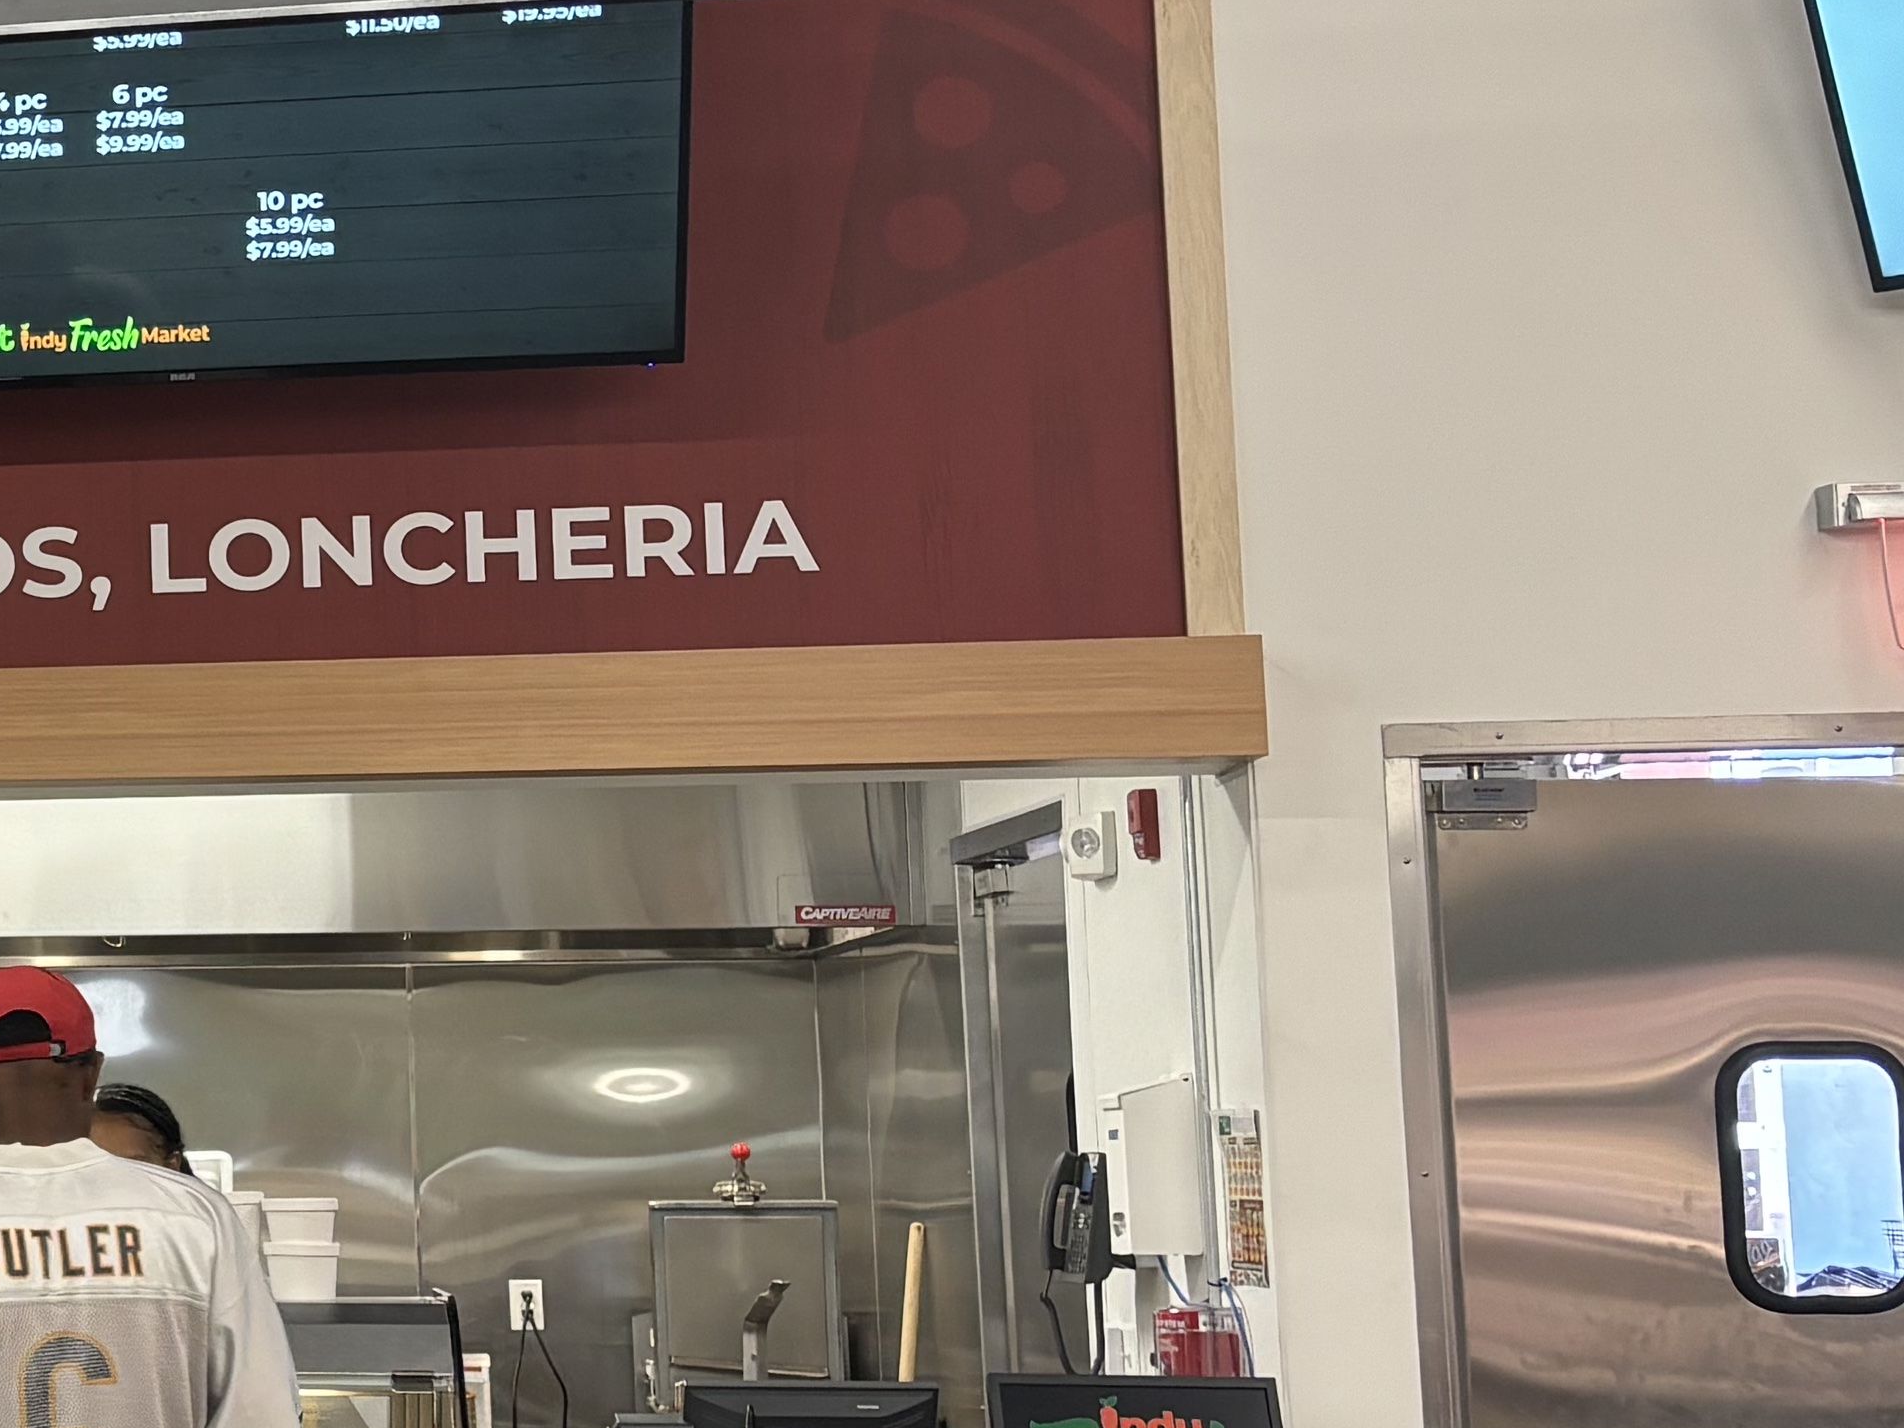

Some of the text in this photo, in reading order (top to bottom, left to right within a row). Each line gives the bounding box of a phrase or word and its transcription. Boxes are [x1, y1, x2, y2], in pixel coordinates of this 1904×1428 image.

[13, 92, 48, 115] pc
[112, 83, 128, 105] 6
[133, 83, 168, 108] pc
[96, 107, 183, 131] $7.99/ea
[96, 132, 184, 156] $9.99/ea
[257, 191, 285, 212] 10
[291, 190, 324, 215] pc
[246, 213, 335, 238] $5.99/ea
[246, 237, 335, 262] $7.99/ea
[70, 315, 139, 351] Fresh
[141, 324, 210, 347] Market
[148, 498, 821, 594] LONCHERIA
